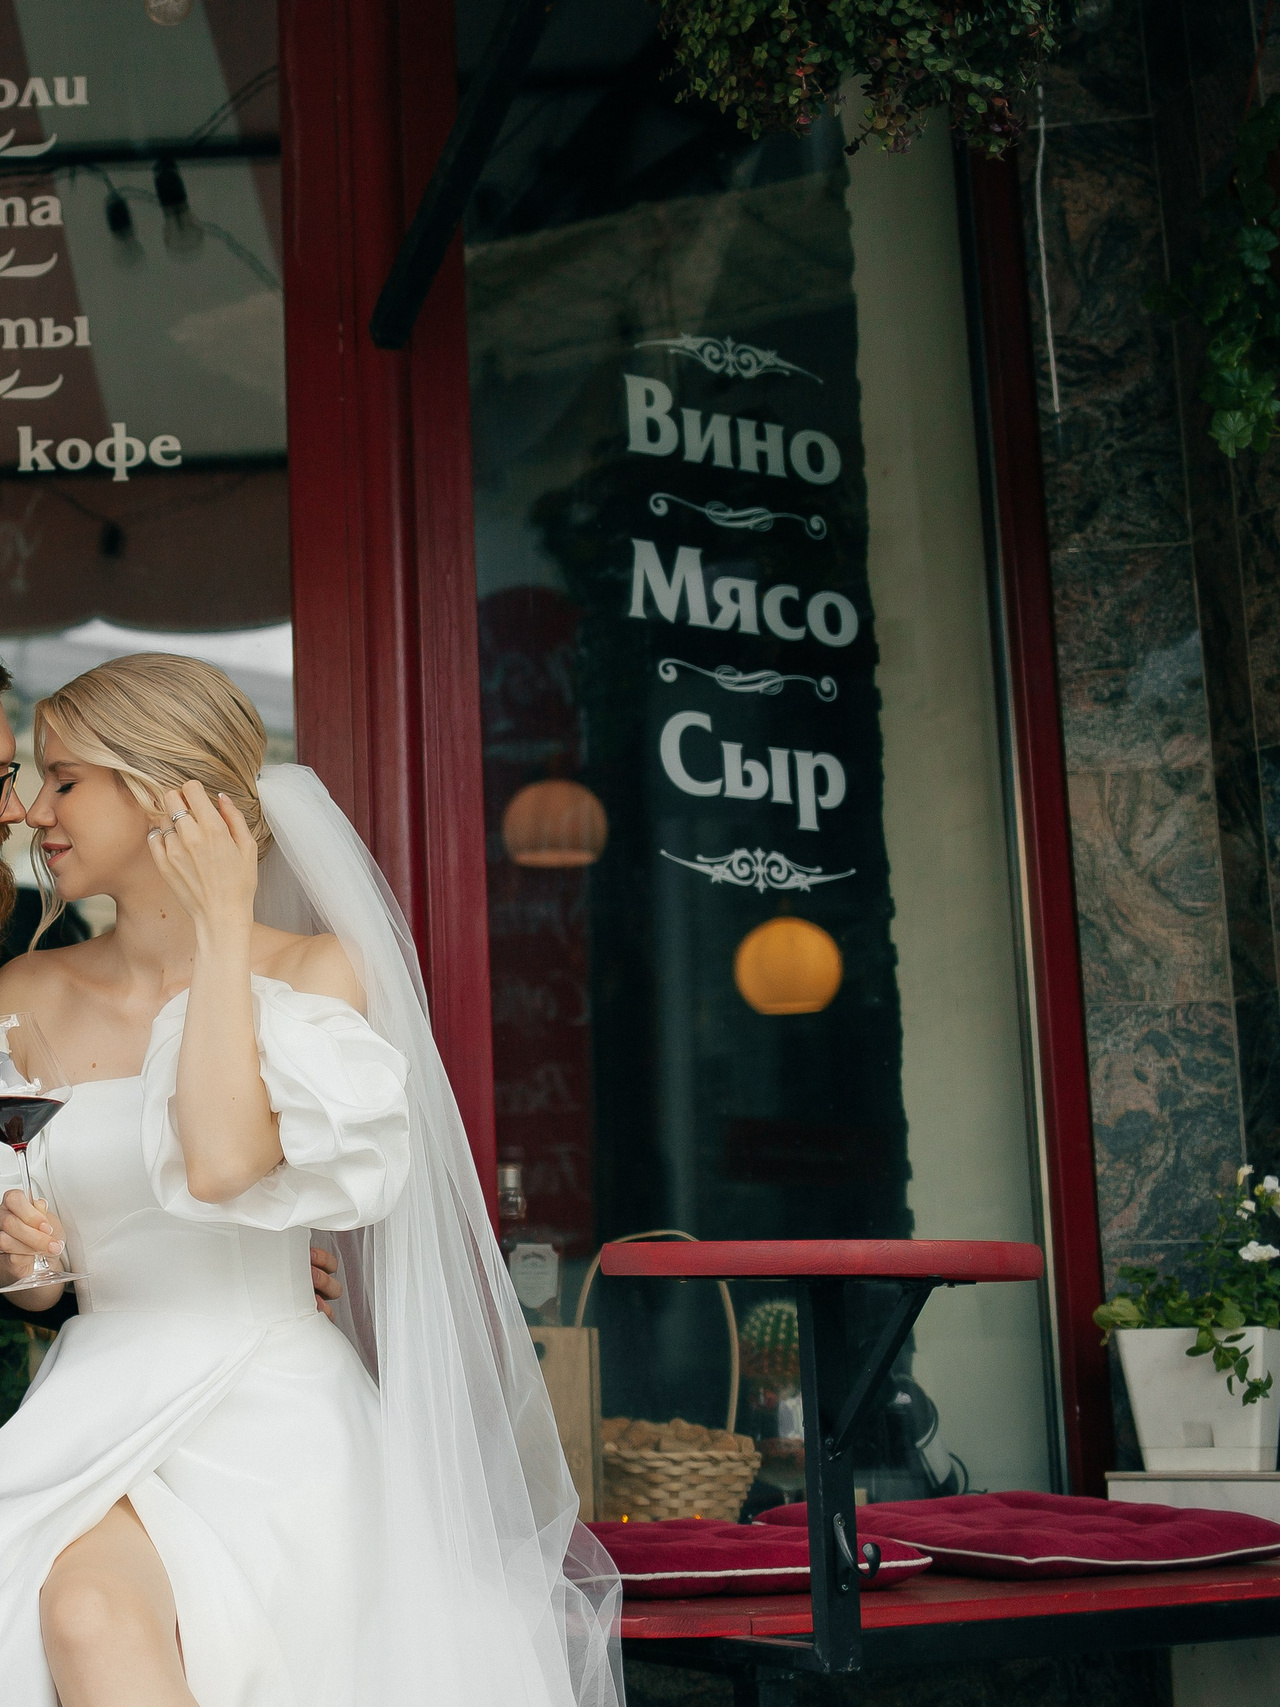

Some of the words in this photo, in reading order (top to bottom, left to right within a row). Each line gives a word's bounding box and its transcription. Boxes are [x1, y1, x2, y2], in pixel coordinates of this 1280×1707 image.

[17, 422, 183, 482] кофе
[624, 373, 842, 486] Вино
[628, 537, 859, 648] Мясо
[659, 710, 847, 832] Сыр
